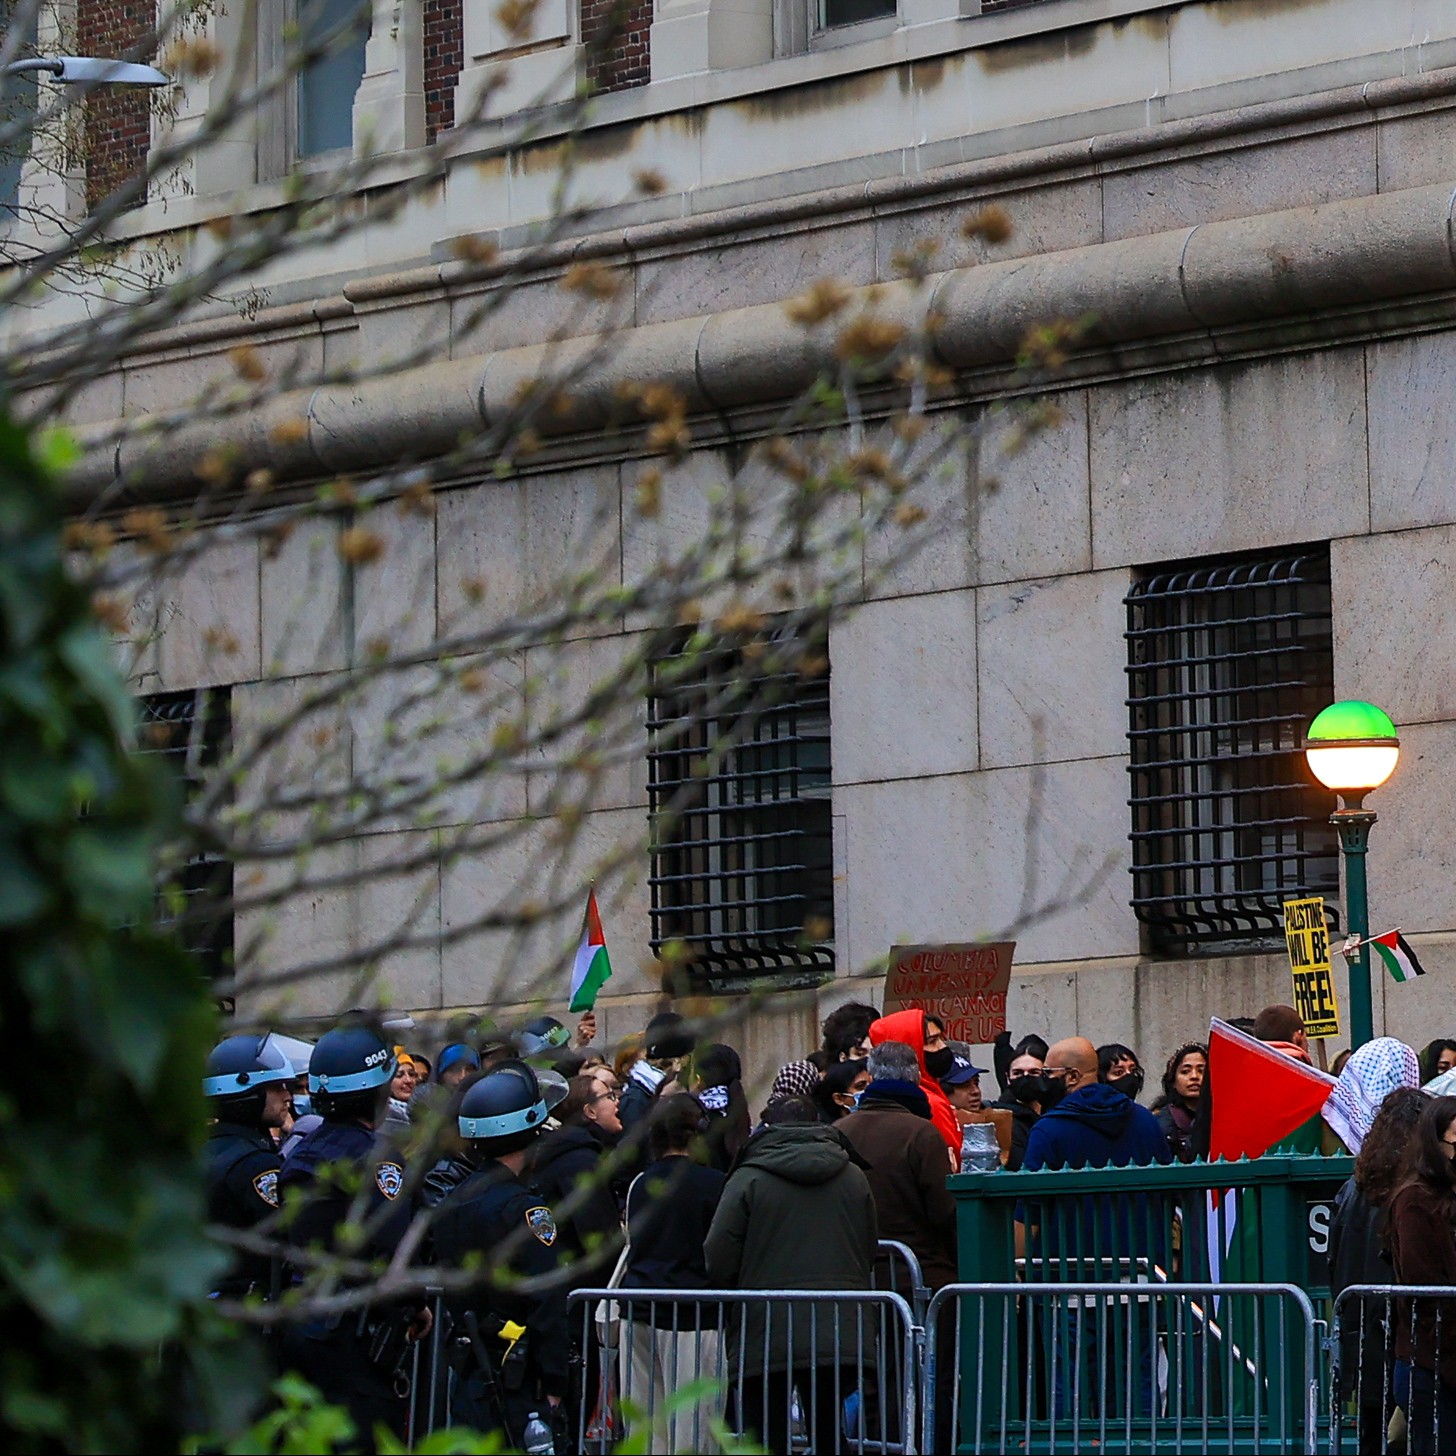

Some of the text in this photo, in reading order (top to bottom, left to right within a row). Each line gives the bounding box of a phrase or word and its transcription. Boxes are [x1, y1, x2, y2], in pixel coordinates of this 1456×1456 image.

[1285, 902, 1323, 931] PALESTINE
[897, 948, 999, 974] COLUMBIA
[1287, 931, 1311, 967] WILL
[1311, 930, 1328, 964] BE
[938, 991, 1007, 1017] CANNOT
[1293, 970, 1336, 1022] FREE!
